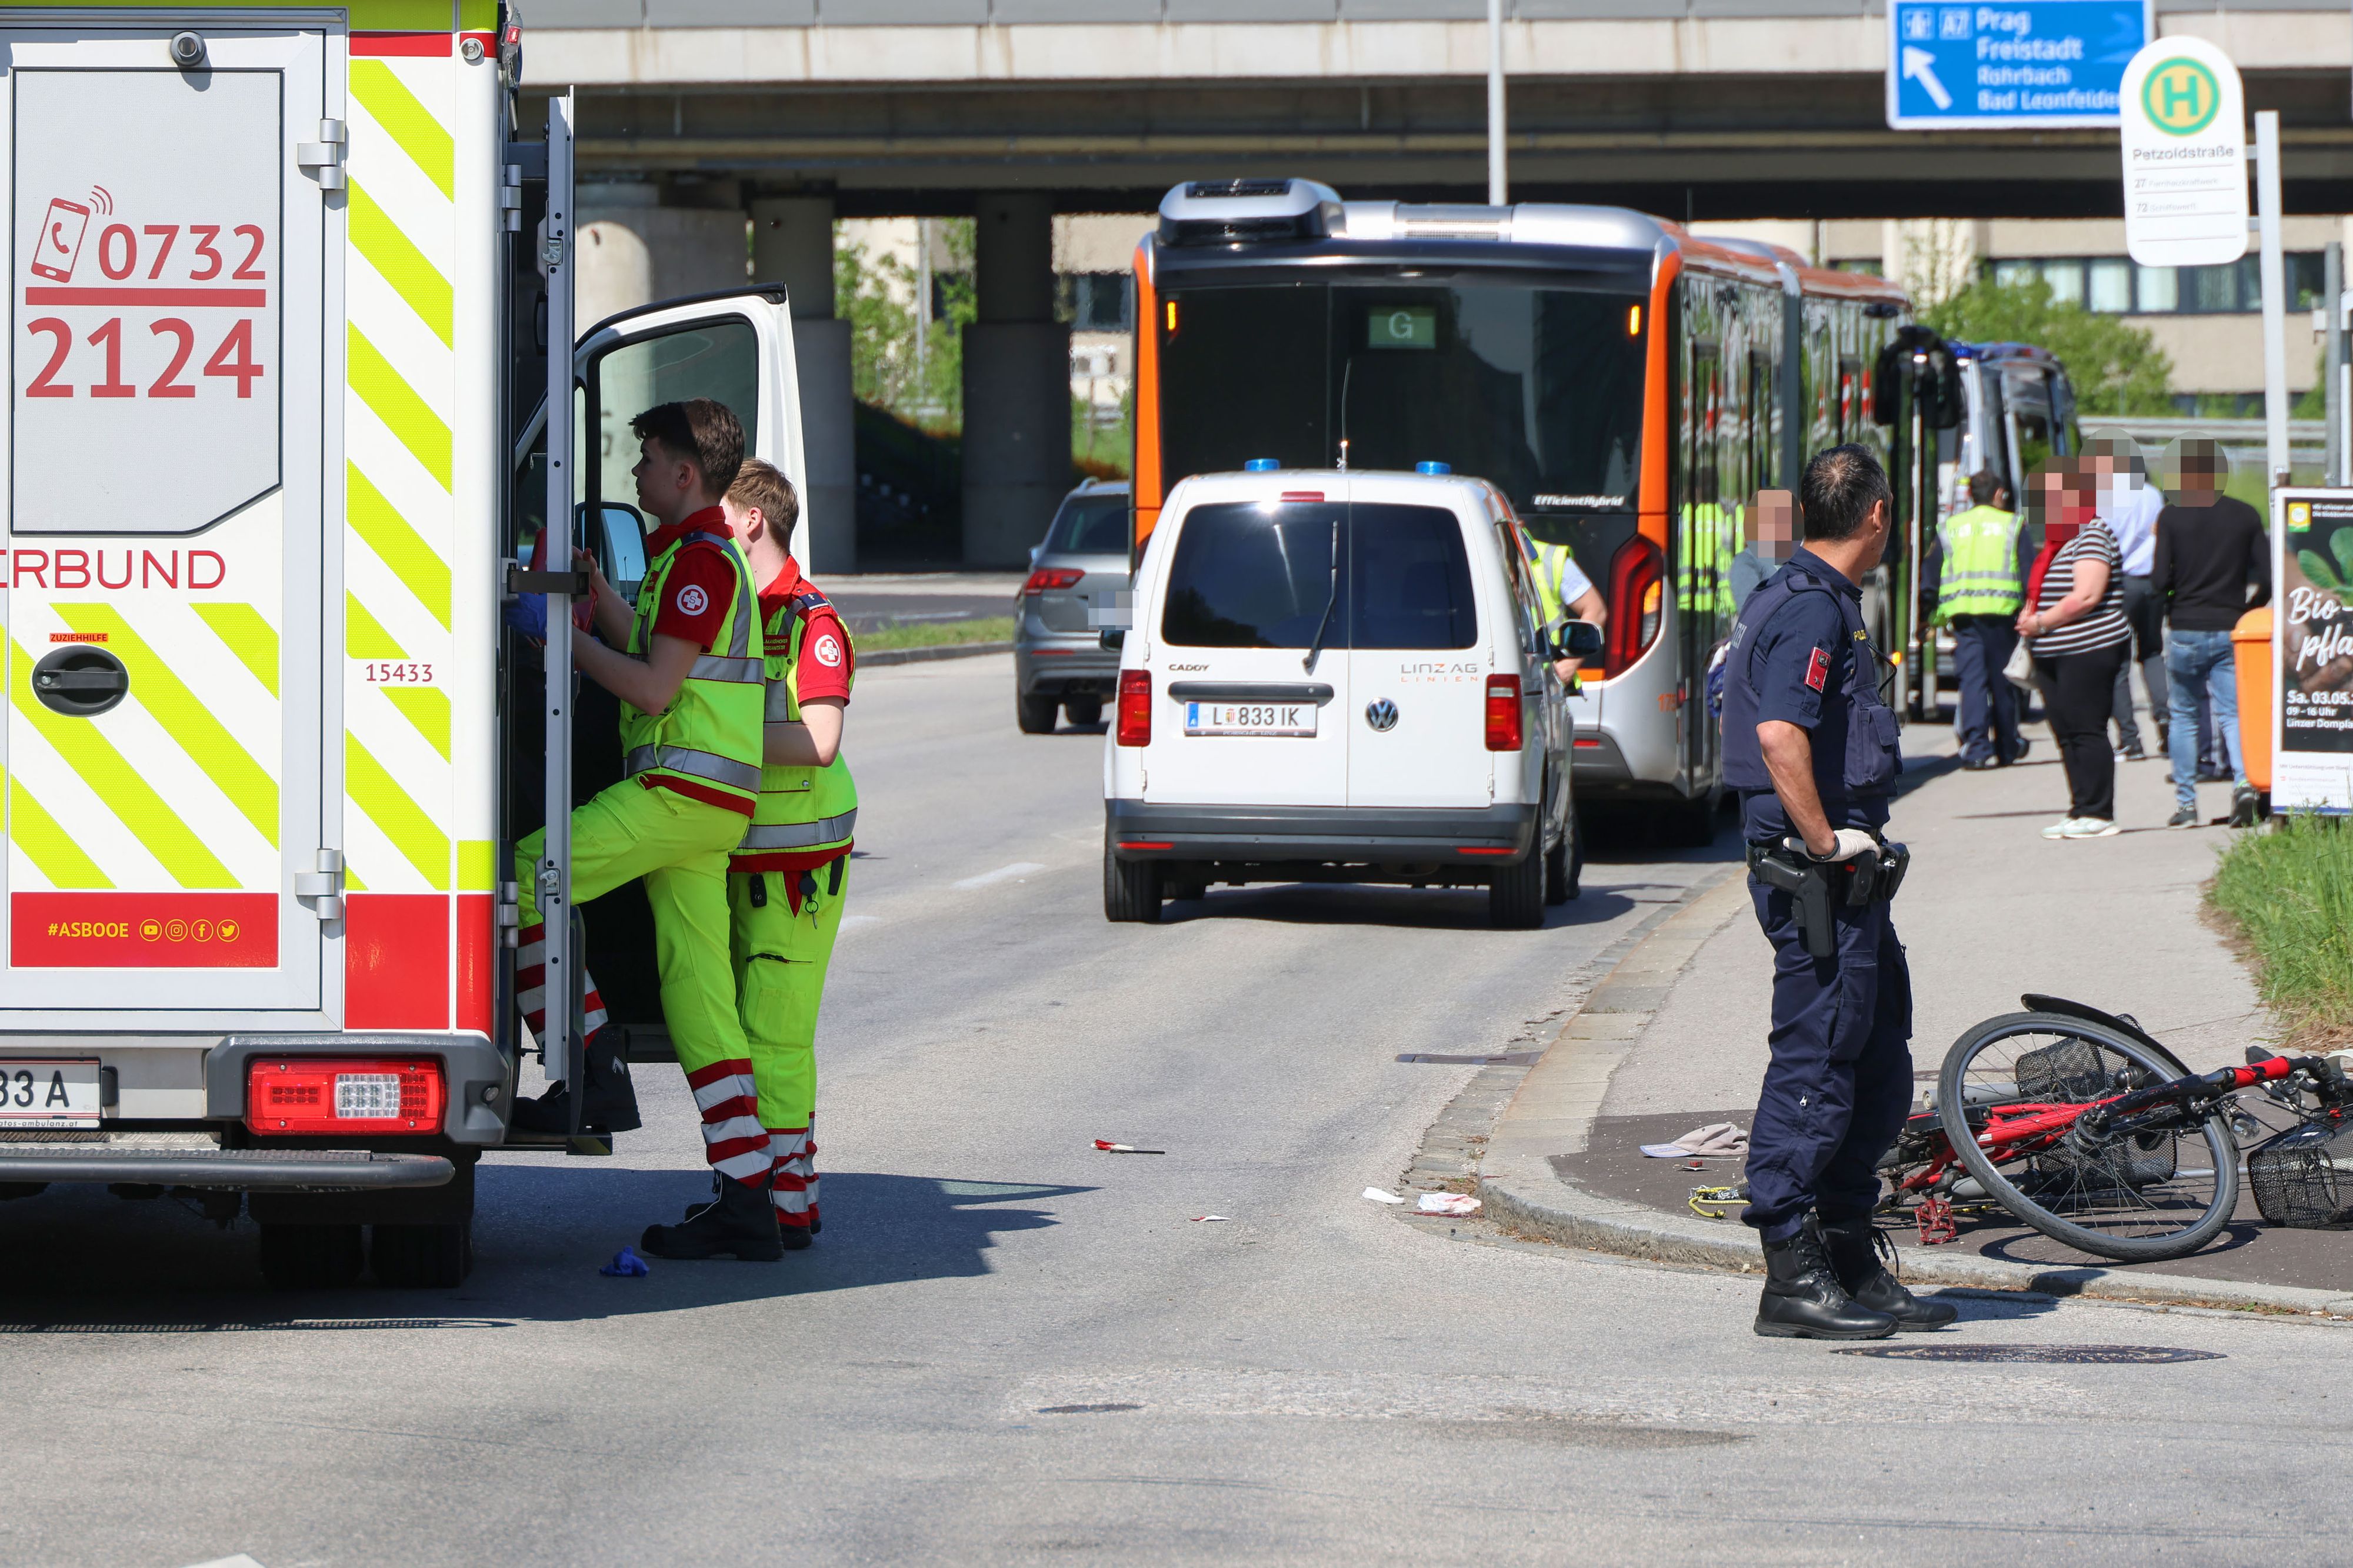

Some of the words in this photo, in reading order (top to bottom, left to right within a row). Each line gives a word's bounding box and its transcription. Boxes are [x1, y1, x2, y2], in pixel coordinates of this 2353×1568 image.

[1976, 7, 2031, 35] Prag
[1977, 36, 2084, 60] Freistadt
[1977, 65, 2071, 86] Rohrbach
[1977, 90, 2018, 111] Bad
[2163, 75, 2198, 117] H
[2133, 146, 2234, 161] Petzoldstraße
[2135, 179, 2146, 188] 27
[99, 223, 266, 281] 0732
[1388, 311, 1412, 339] G
[26, 318, 264, 398] 2124
[1534, 495, 1624, 508] EfficientHybrid
[0, 549, 226, 589] RBUND
[366, 663, 433, 682] 15433
[1401, 663, 1445, 674] LINZ
[1450, 663, 1478, 673] AG
[2287, 689, 2309, 704] Sa.
[1213, 707, 1222, 726] L
[1239, 708, 1274, 726] 833
[1281, 708, 1299, 726] IK
[2286, 706, 2301, 716] 09
[2307, 706, 2318, 716] 16
[2318, 706, 2338, 716] Uhr
[2286, 718, 2315, 728] Linzer
[48, 922, 129, 938] #ASBOOE
[45, 1070, 70, 1107] A
